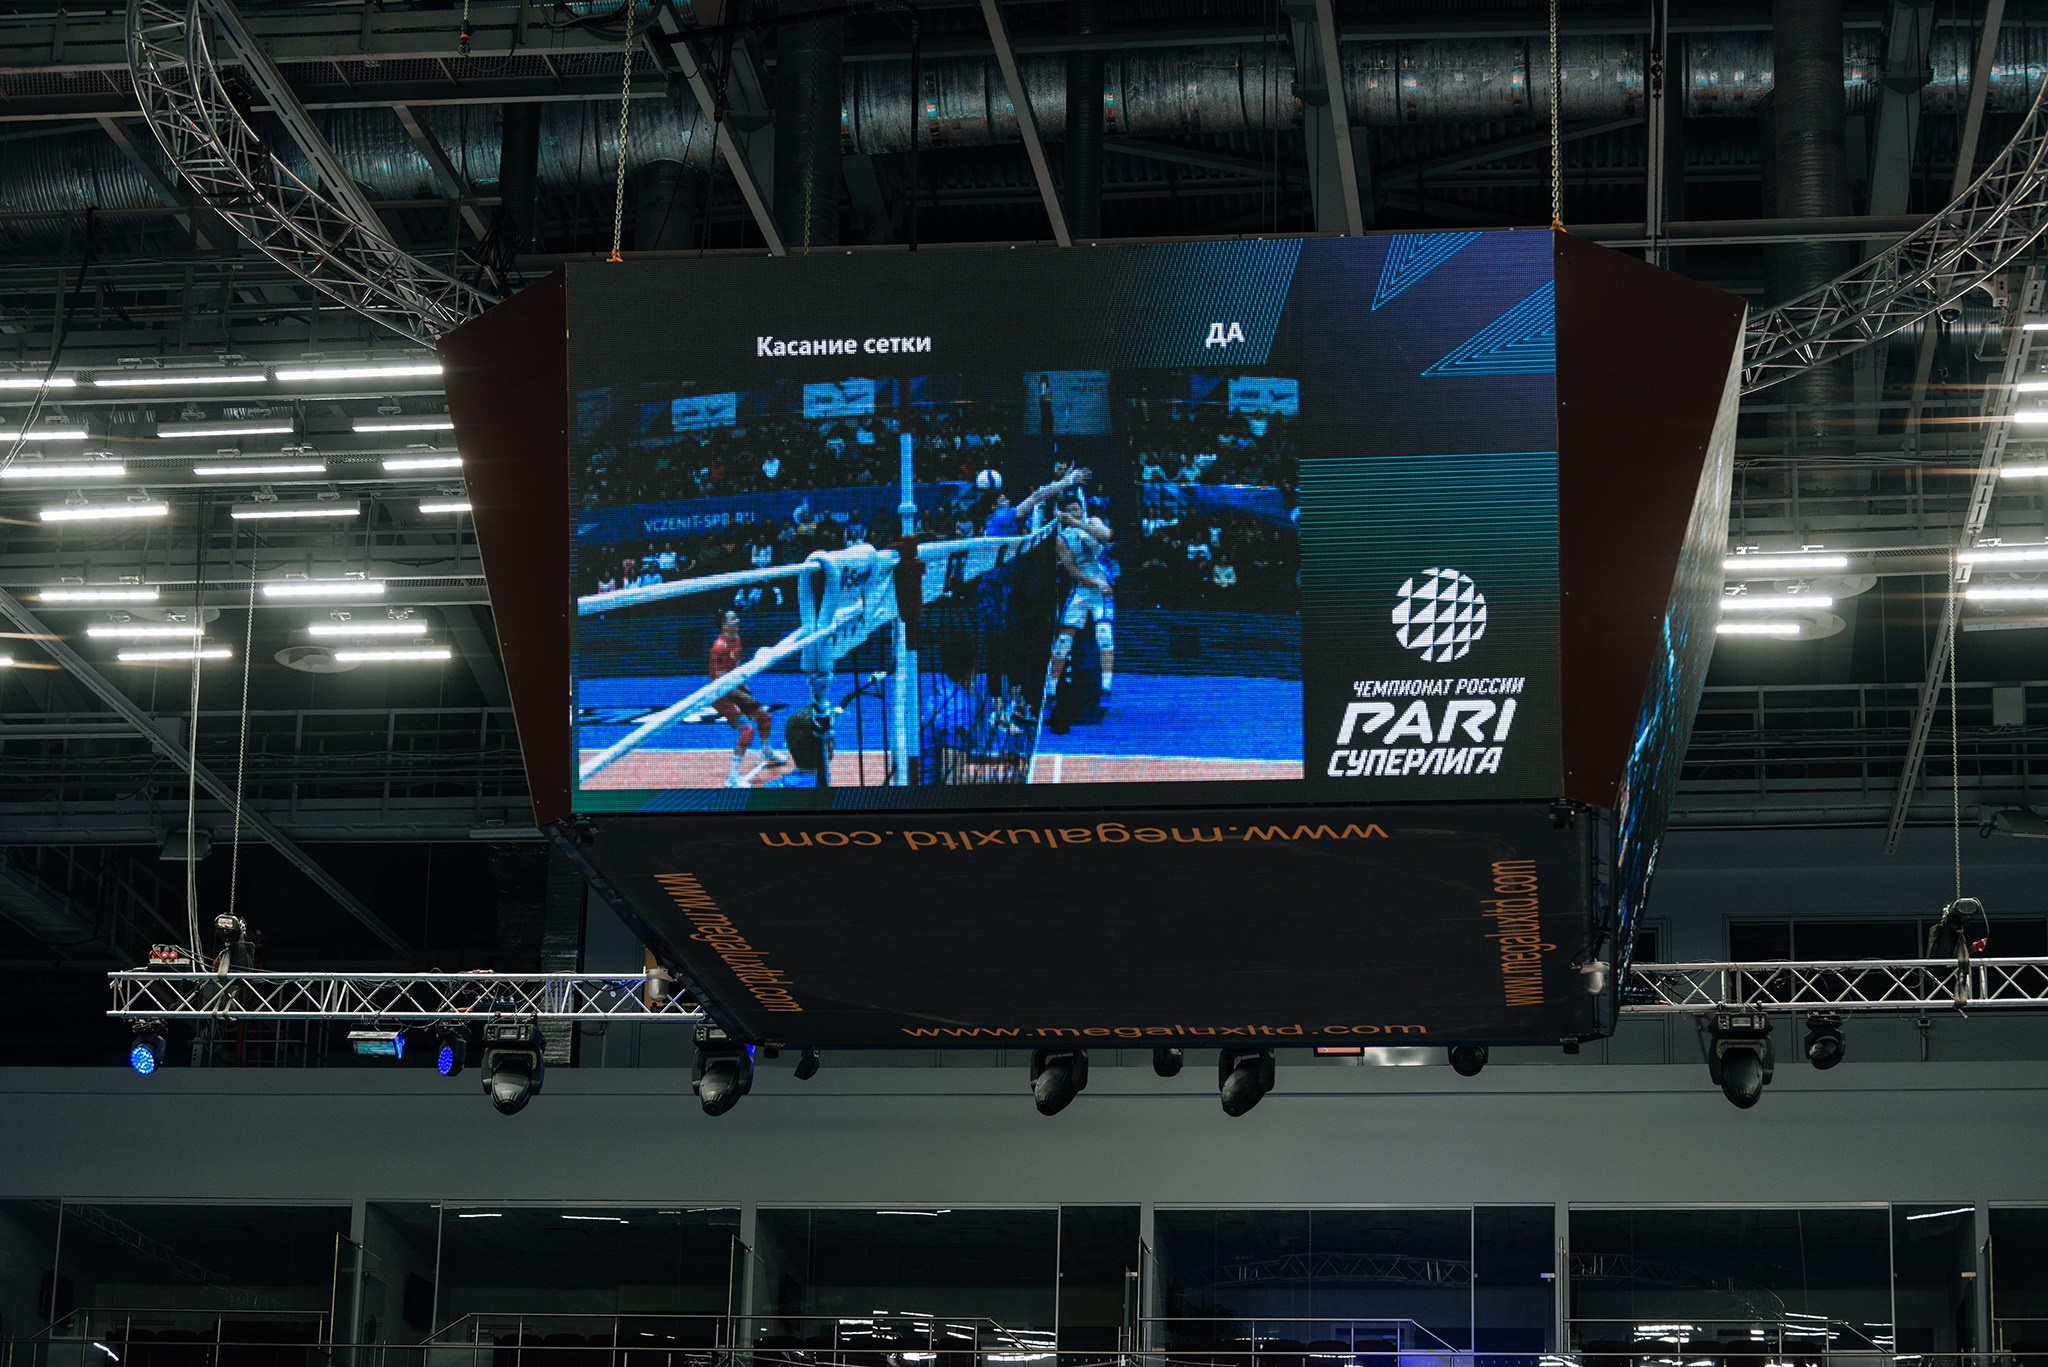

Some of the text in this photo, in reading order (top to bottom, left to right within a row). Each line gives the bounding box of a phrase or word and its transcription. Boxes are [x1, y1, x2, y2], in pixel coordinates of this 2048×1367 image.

[756, 335, 932, 358] Касание сетки
[1205, 321, 1246, 349] ДА
[643, 512, 756, 532] VCZENIT-SPBRU
[1353, 676, 1526, 698] ЧЕМПИОНАТ РОССИИ
[1336, 698, 1519, 746] PARI
[1327, 747, 1504, 777] СУПЕРЛИГА
[759, 822, 1389, 851] www.megaluxltd.com
[654, 872, 803, 1013] www.megaluxltd.com
[1481, 859, 1556, 1007] www.megaluxltd.com
[903, 1024, 1428, 1039] www.megaluxltd.com
